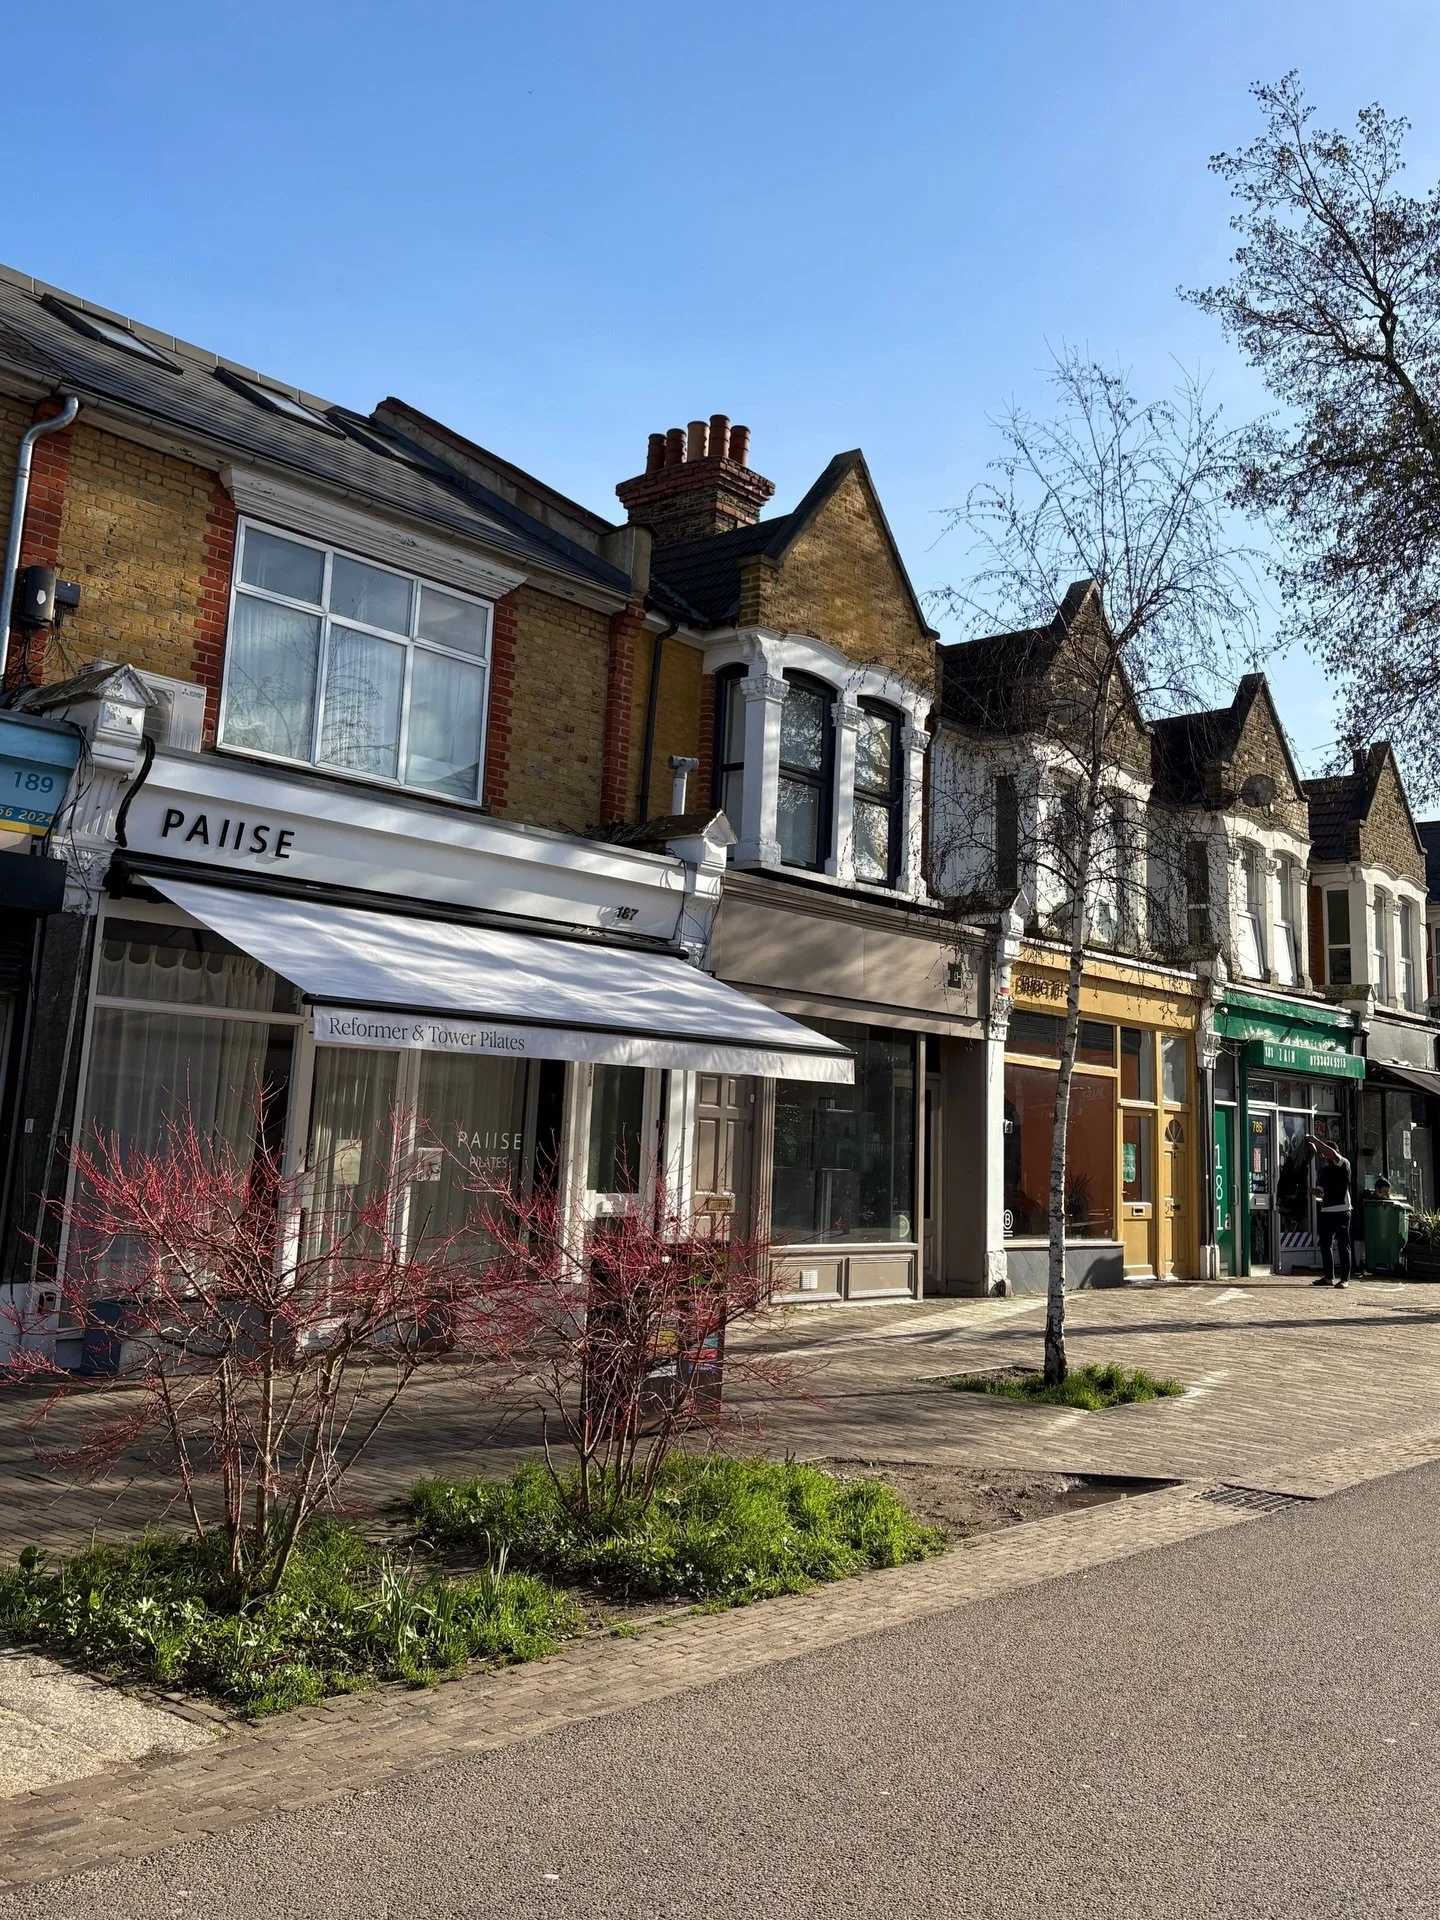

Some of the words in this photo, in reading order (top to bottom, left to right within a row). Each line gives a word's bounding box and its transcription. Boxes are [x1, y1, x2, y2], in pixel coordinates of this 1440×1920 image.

[14, 771, 54, 793] 189
[615, 906, 639, 921] 187
[329, 1017, 408, 1040] Reformer
[412, 1024, 424, 1042] &
[429, 1025, 477, 1046] Tower
[480, 1031, 525, 1050] Pilates
[1252, 1120, 1263, 1134] 786
